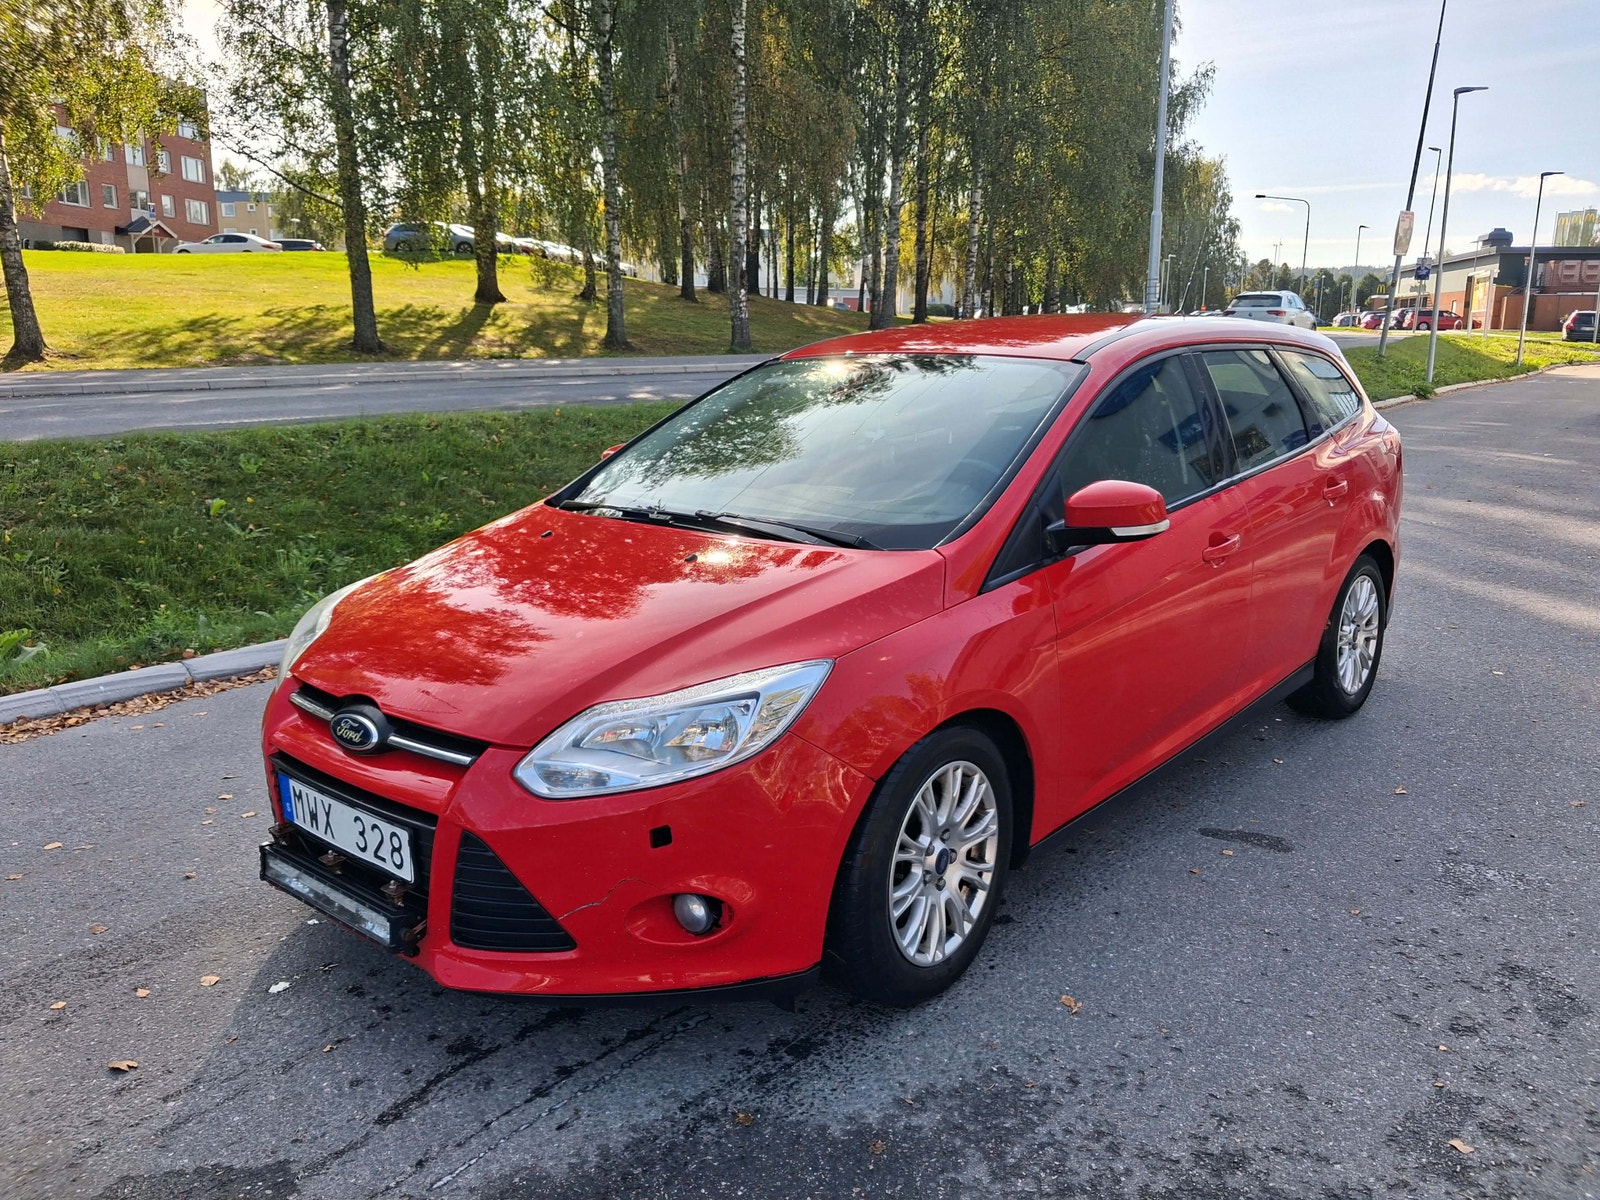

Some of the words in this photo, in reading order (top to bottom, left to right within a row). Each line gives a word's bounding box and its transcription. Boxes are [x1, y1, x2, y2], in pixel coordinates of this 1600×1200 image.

[336, 718, 364, 743] Ford
[292, 785, 335, 839] MWX
[353, 815, 404, 870] 328
